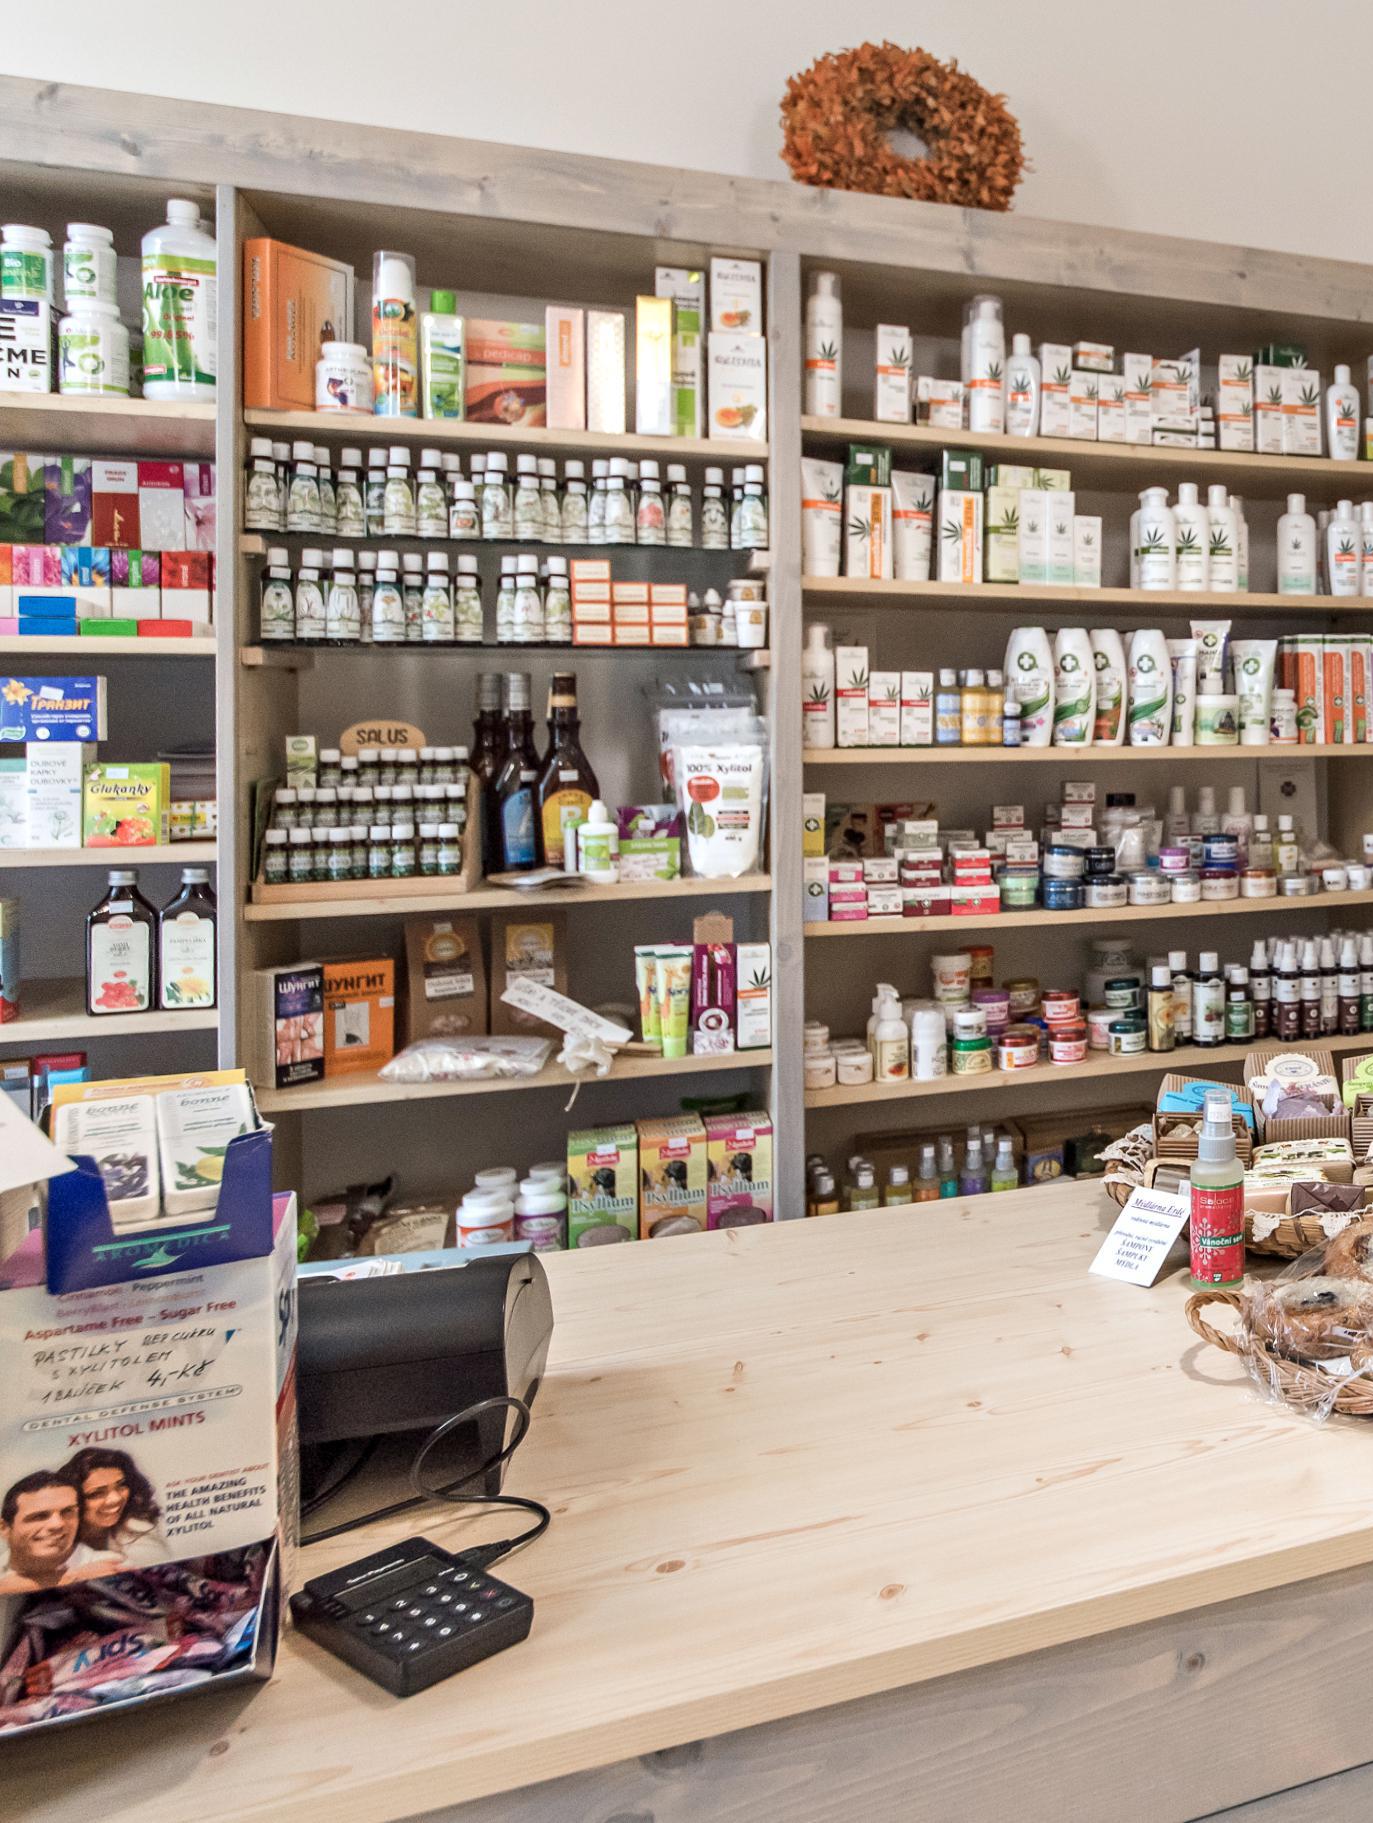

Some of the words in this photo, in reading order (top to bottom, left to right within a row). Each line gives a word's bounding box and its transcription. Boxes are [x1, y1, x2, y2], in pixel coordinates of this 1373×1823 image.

[145, 282, 195, 302] Aloe
[0, 347, 47, 365] ME
[356, 727, 409, 746] SALUS
[716, 762, 752, 774] Xylitol
[90, 782, 152, 797] Glukanky
[1202, 1235, 1232, 1247] Vánoční
[131, 1274, 204, 1293] Peppermint
[24, 1319, 108, 1341] Aspartame
[111, 1314, 144, 1330] Free
[159, 1304, 203, 1322] Sugar
[205, 1299, 237, 1313] Free
[29, 1412, 91, 1431] DENTAL
[99, 1398, 170, 1418] DEFENSE
[66, 1420, 144, 1449] XYLITOL
[149, 1409, 207, 1433] MINTS
[166, 1487, 188, 1500] THE
[190, 1476, 247, 1496] AMAZING
[166, 1495, 211, 1514] HEALTH
[213, 1484, 267, 1503] BENEFITS
[166, 1513, 183, 1527] OF
[184, 1508, 207, 1523] ALL
[208, 1498, 263, 1516] NATURAL
[166, 1519, 215, 1539] XYLITOL
